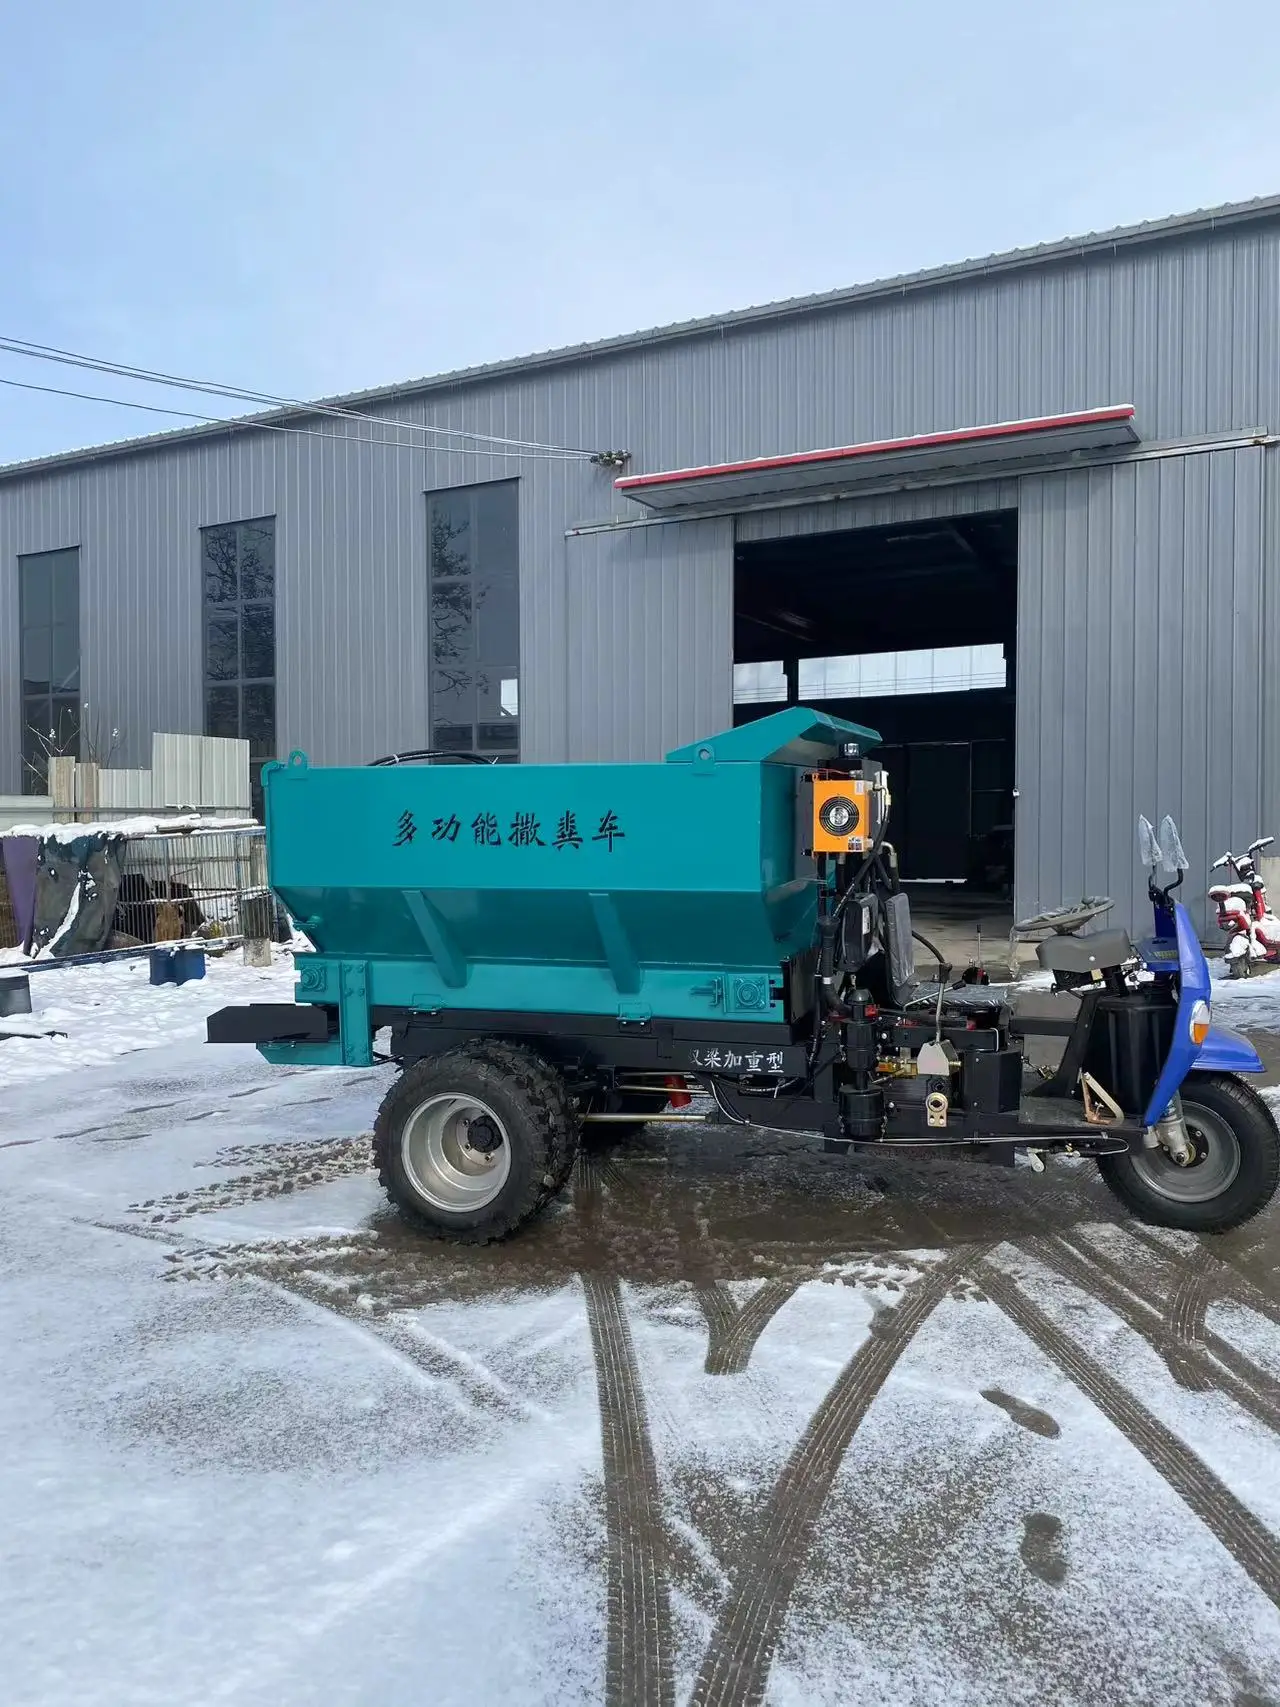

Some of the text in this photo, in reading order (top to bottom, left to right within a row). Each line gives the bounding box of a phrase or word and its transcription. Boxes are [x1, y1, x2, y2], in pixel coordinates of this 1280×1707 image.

[392, 809, 625, 853] 多功能撒粪车
